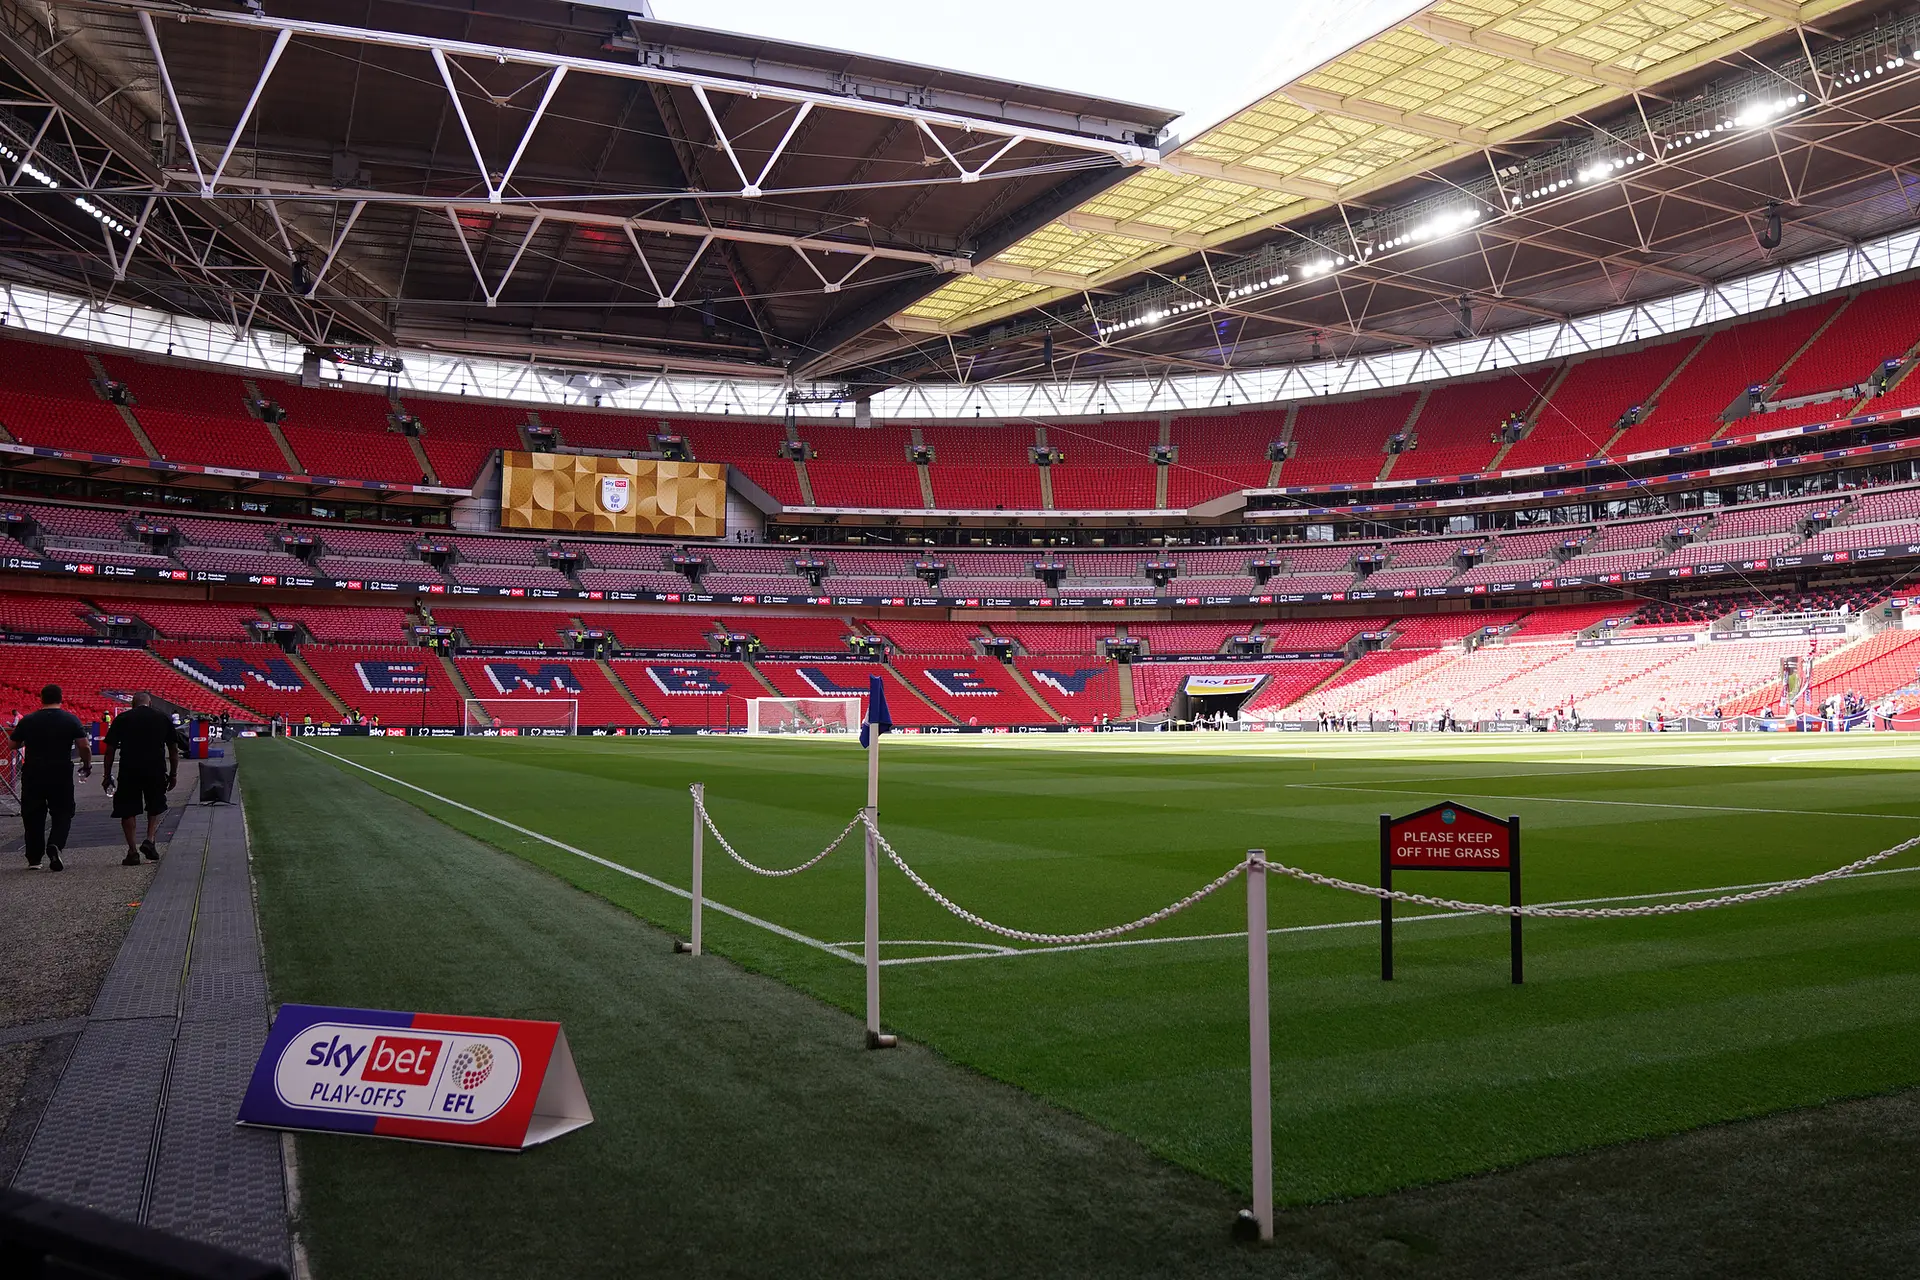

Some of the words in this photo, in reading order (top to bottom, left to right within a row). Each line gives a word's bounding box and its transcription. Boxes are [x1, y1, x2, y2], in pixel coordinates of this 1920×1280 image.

[1908, 545, 1920, 553] sky
[1822, 554, 1834, 562] sky
[1835, 552, 1848, 562] bet
[65, 563, 78, 572] sky
[79, 564, 94, 573] bet
[1754, 560, 1767, 569] bet
[159, 570, 171, 578] sky
[172, 571, 187, 580] bet
[1680, 567, 1692, 576] bet
[249, 576, 261, 584] sky
[262, 576, 276, 584] bet
[348, 581, 361, 589] bet
[430, 585, 444, 593] bet
[1196, 678, 1221, 686] sky
[1615, 722, 1626, 731] sky
[369, 728, 385, 737] sky
[387, 728, 405, 736] bet
[484, 728, 499, 736] sky
[501, 728, 517, 736] bet
[1404, 832, 1454, 842] PLEASE
[1458, 832, 1493, 843] KEEP
[1397, 846, 1422, 857] OFF
[1426, 847, 1451, 858] THE
[1454, 848, 1500, 859] GRASS
[305, 1034, 367, 1076] sky
[372, 1040, 432, 1075] bet
[310, 1082, 407, 1108] PLAY-OFFS
[442, 1093, 476, 1114] EFL
